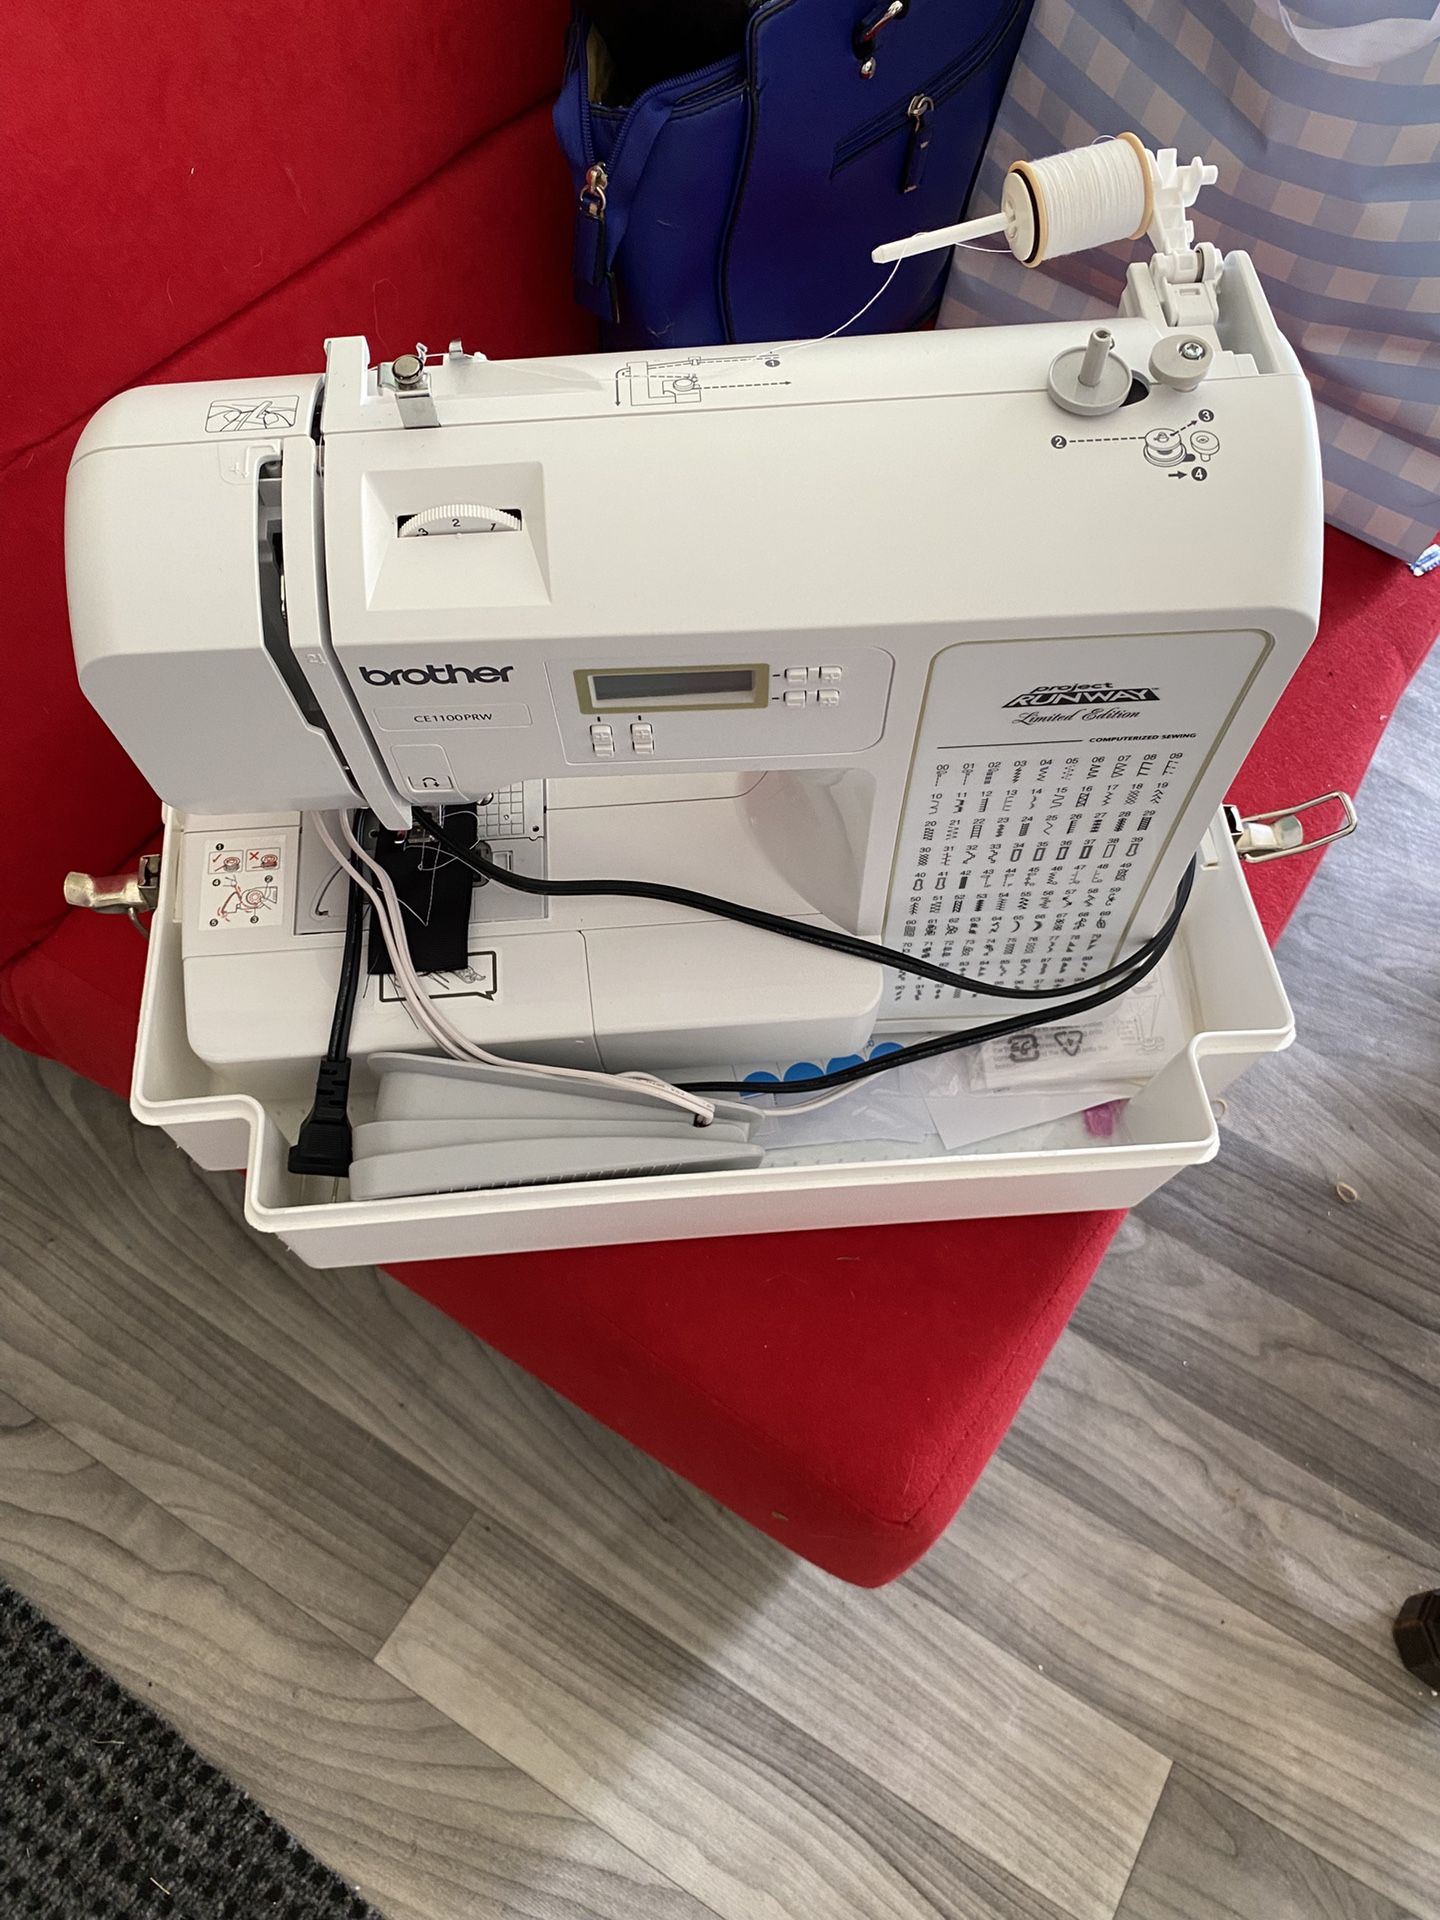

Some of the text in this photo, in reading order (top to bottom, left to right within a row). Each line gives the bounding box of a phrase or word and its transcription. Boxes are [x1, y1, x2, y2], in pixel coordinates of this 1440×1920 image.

[452, 518, 460, 527] 2
[490, 523, 496, 532] 1
[359, 664, 514, 686] brother
[1030, 682, 1114, 694] project
[1005, 688, 1151, 707] RUNWAY
[414, 713, 493, 724] CE1100PRW
[1012, 707, 1140, 726] Limited Edition
[1089, 734, 1159, 743] COMPUTERIZED
